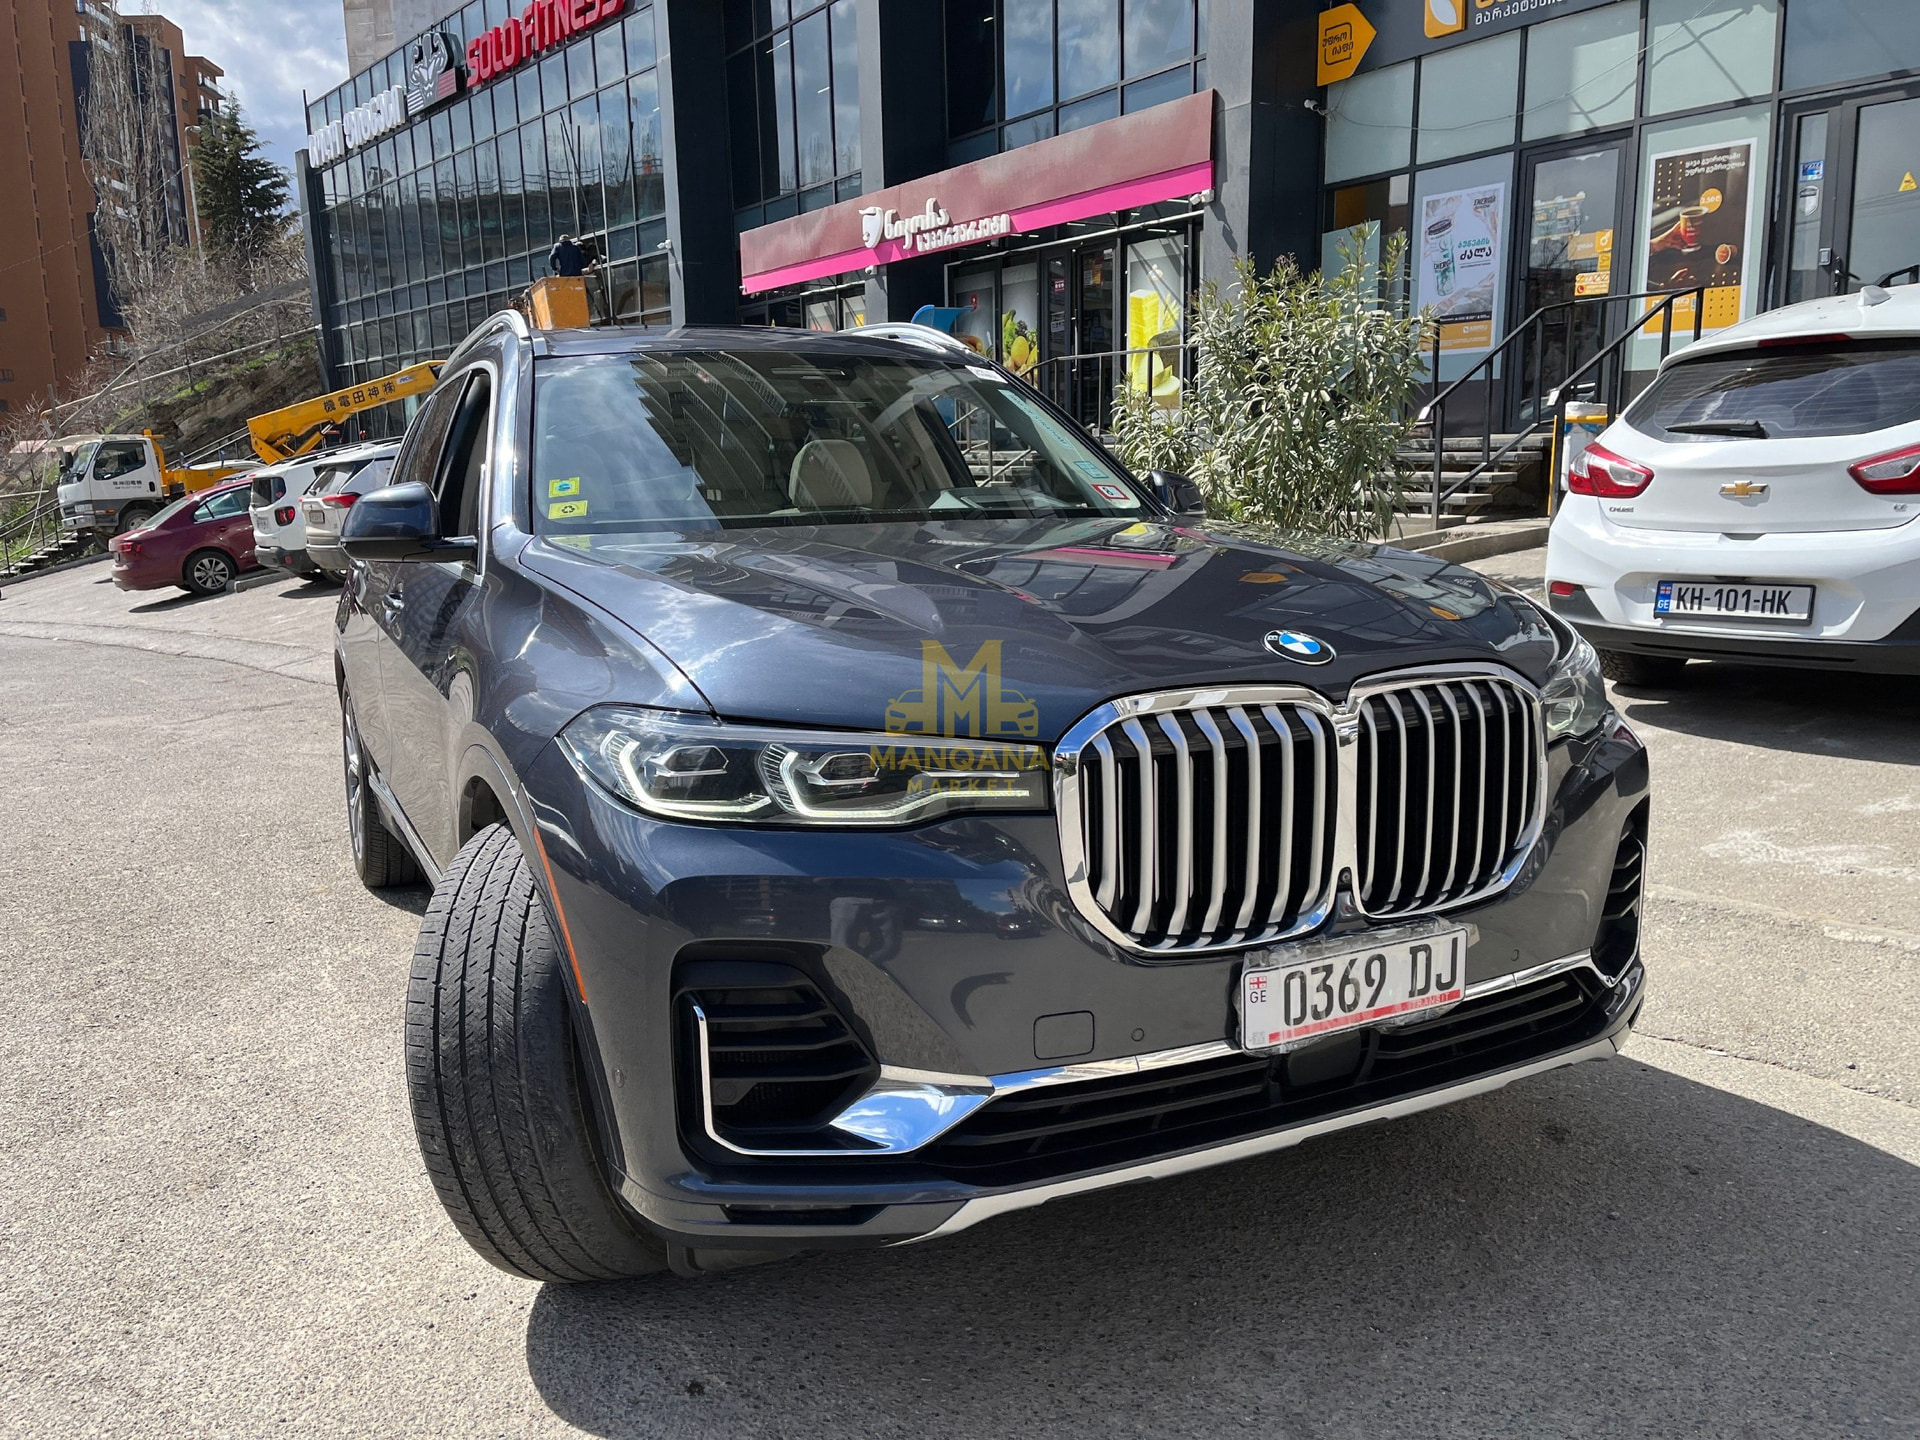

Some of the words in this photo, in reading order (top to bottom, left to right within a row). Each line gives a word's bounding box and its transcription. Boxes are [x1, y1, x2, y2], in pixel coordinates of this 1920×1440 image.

[466, 18, 522, 87] SOLO
[1460, 246, 1492, 260] ძალა
[1657, 599, 1669, 609] GE
[1676, 586, 1792, 615] KH-101-HK
[1250, 990, 1267, 1003] GE
[1284, 953, 1387, 1026] 0369
[1408, 937, 1459, 998] DJ
